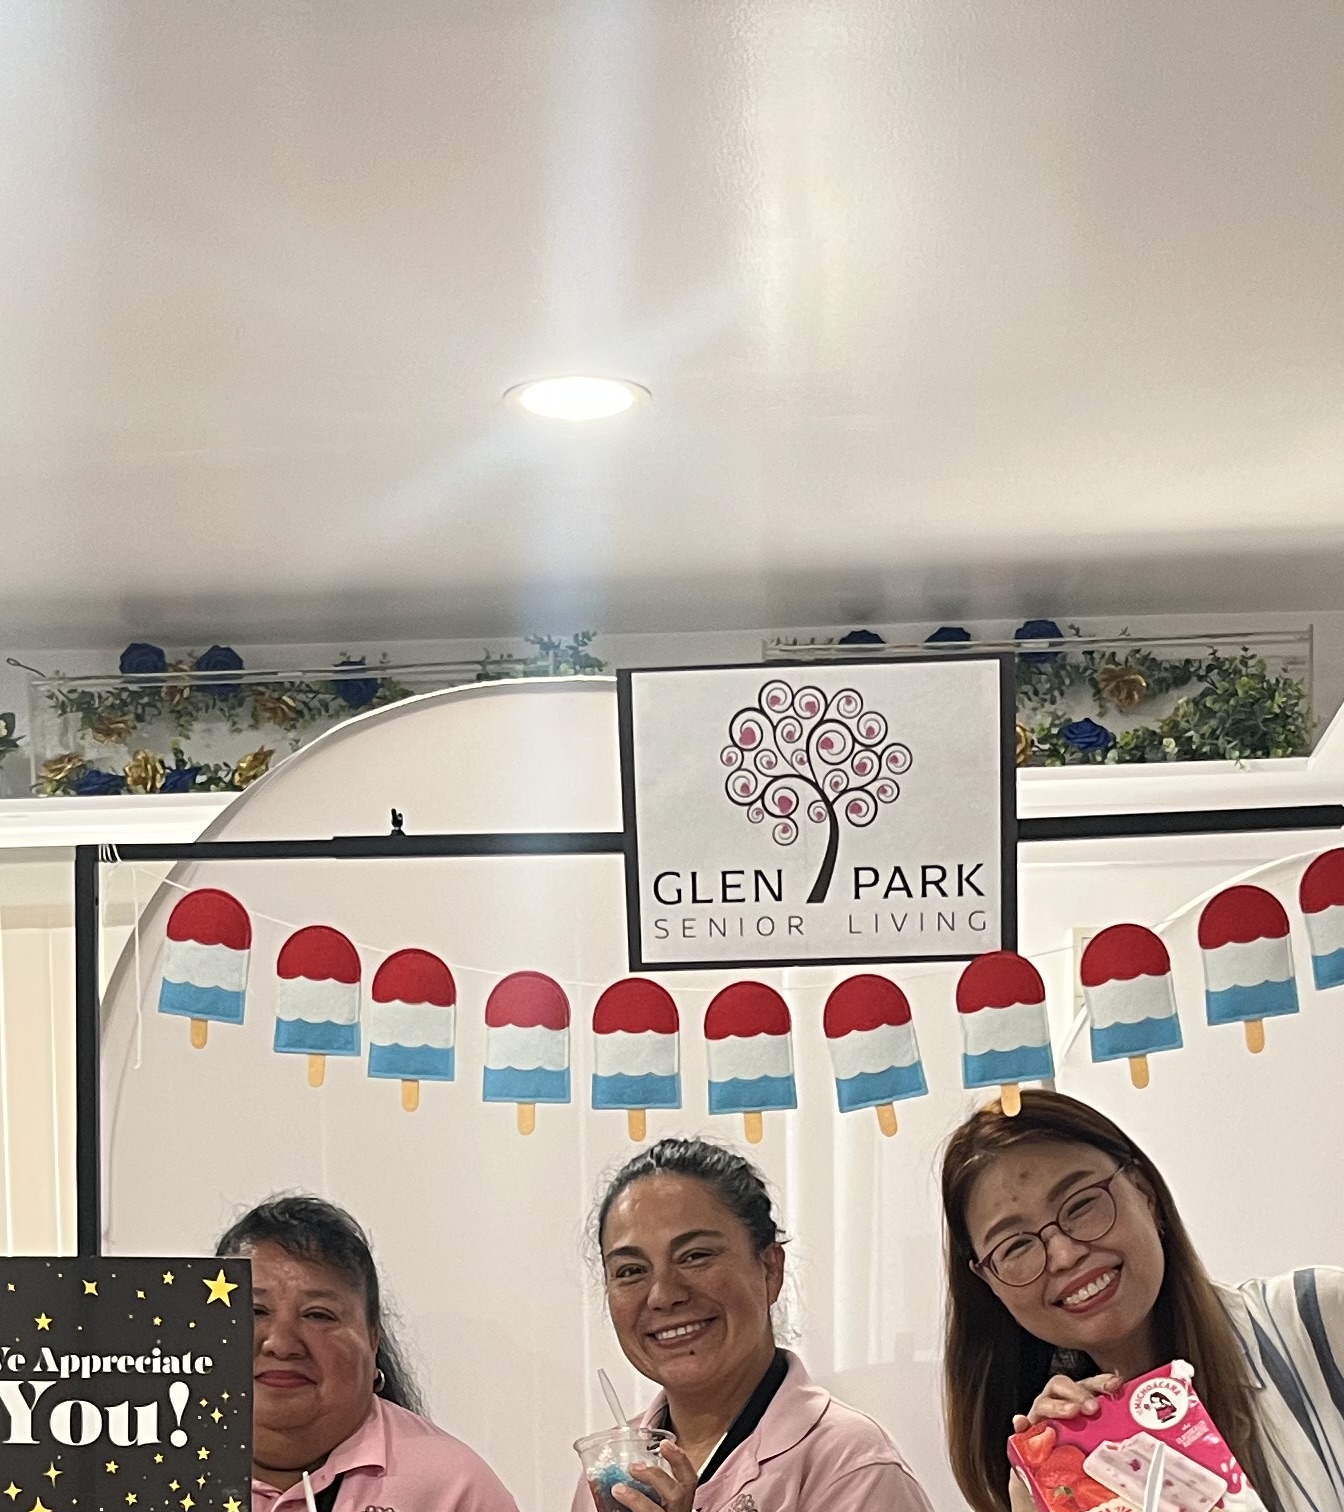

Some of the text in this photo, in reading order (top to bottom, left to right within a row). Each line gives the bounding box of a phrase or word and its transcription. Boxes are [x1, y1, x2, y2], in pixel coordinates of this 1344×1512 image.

[654, 863, 985, 905] GLEN PARK
[654, 910, 988, 939] SENIOR LIVING
[33, 1347, 213, 1379] Appreciate
